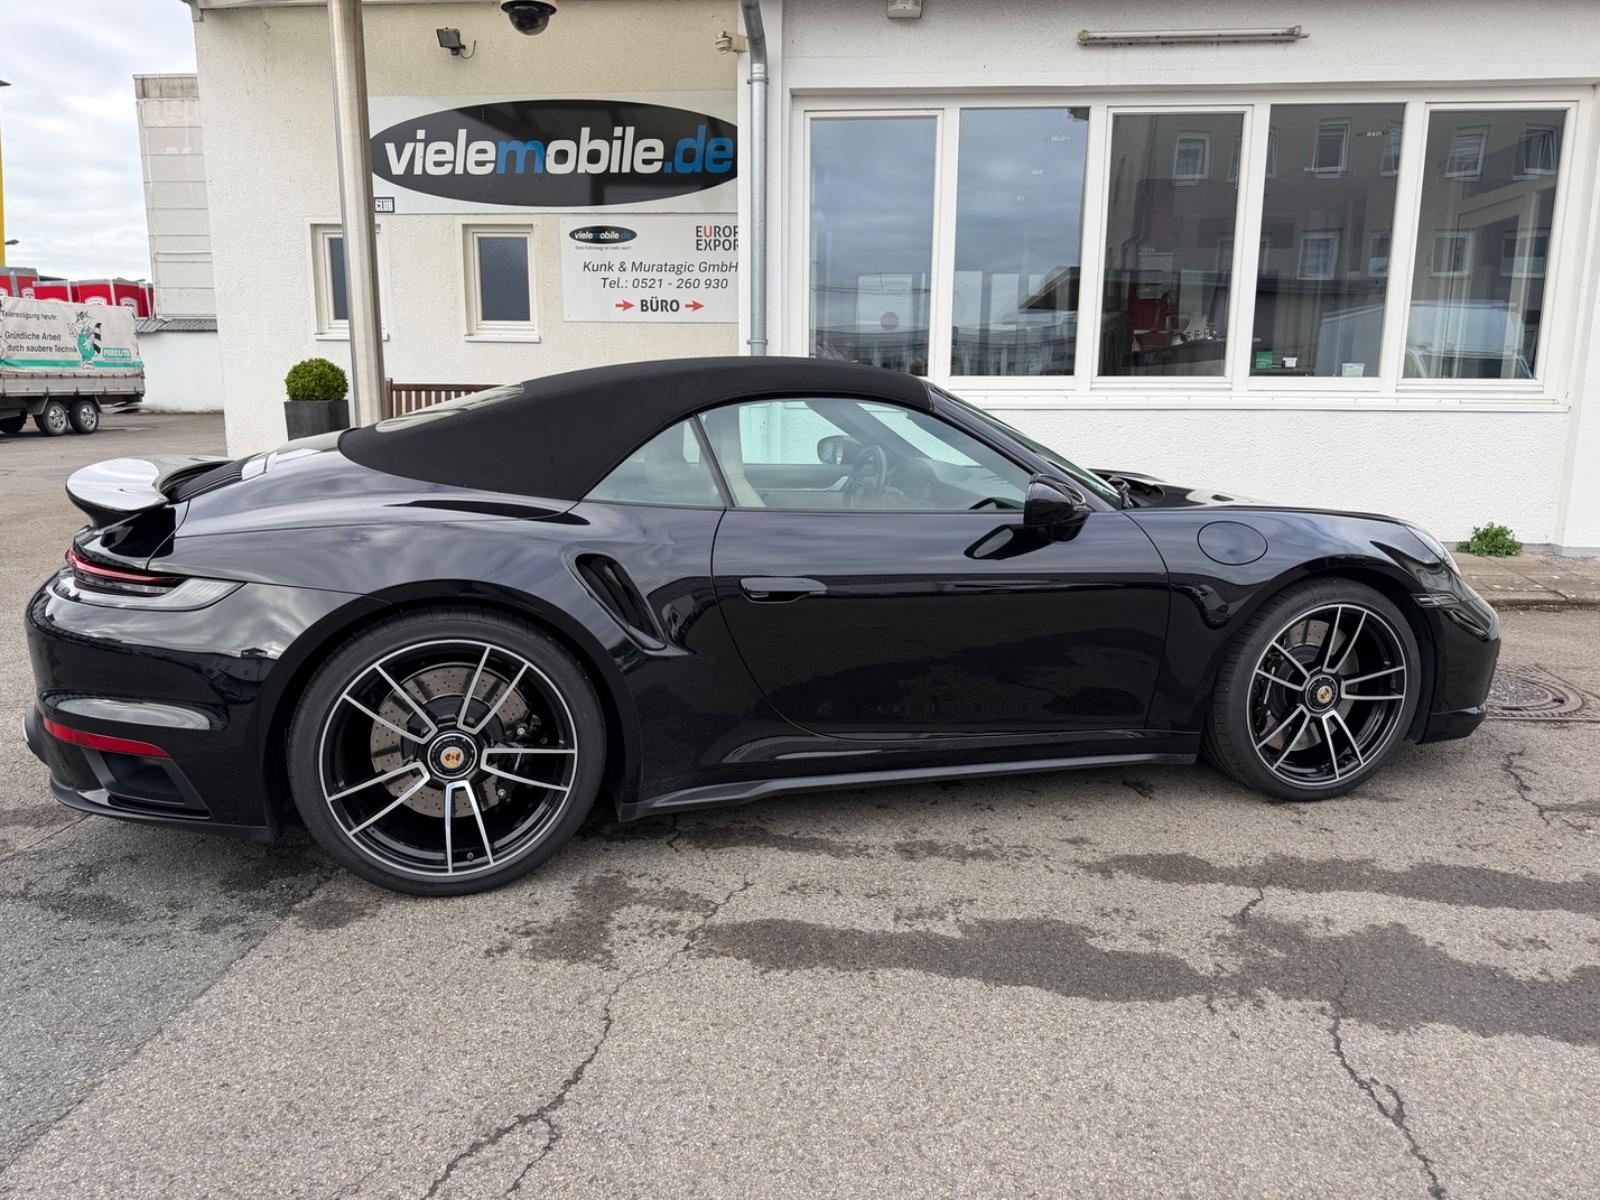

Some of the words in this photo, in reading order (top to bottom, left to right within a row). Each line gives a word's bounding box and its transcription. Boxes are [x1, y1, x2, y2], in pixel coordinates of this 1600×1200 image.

[385, 124, 734, 177] vielemobile.de
[583, 261, 614, 273] Kunk
[618, 262, 627, 273] &
[630, 261, 695, 275] Muratagic
[698, 261, 739, 273] GmbH
[601, 277, 628, 289] Tel.:
[632, 278, 663, 289] 0521
[676, 278, 701, 289] 260
[704, 278, 729, 289] 930
[640, 296, 680, 313] BÜRO
[26, 345, 53, 353] saubere
